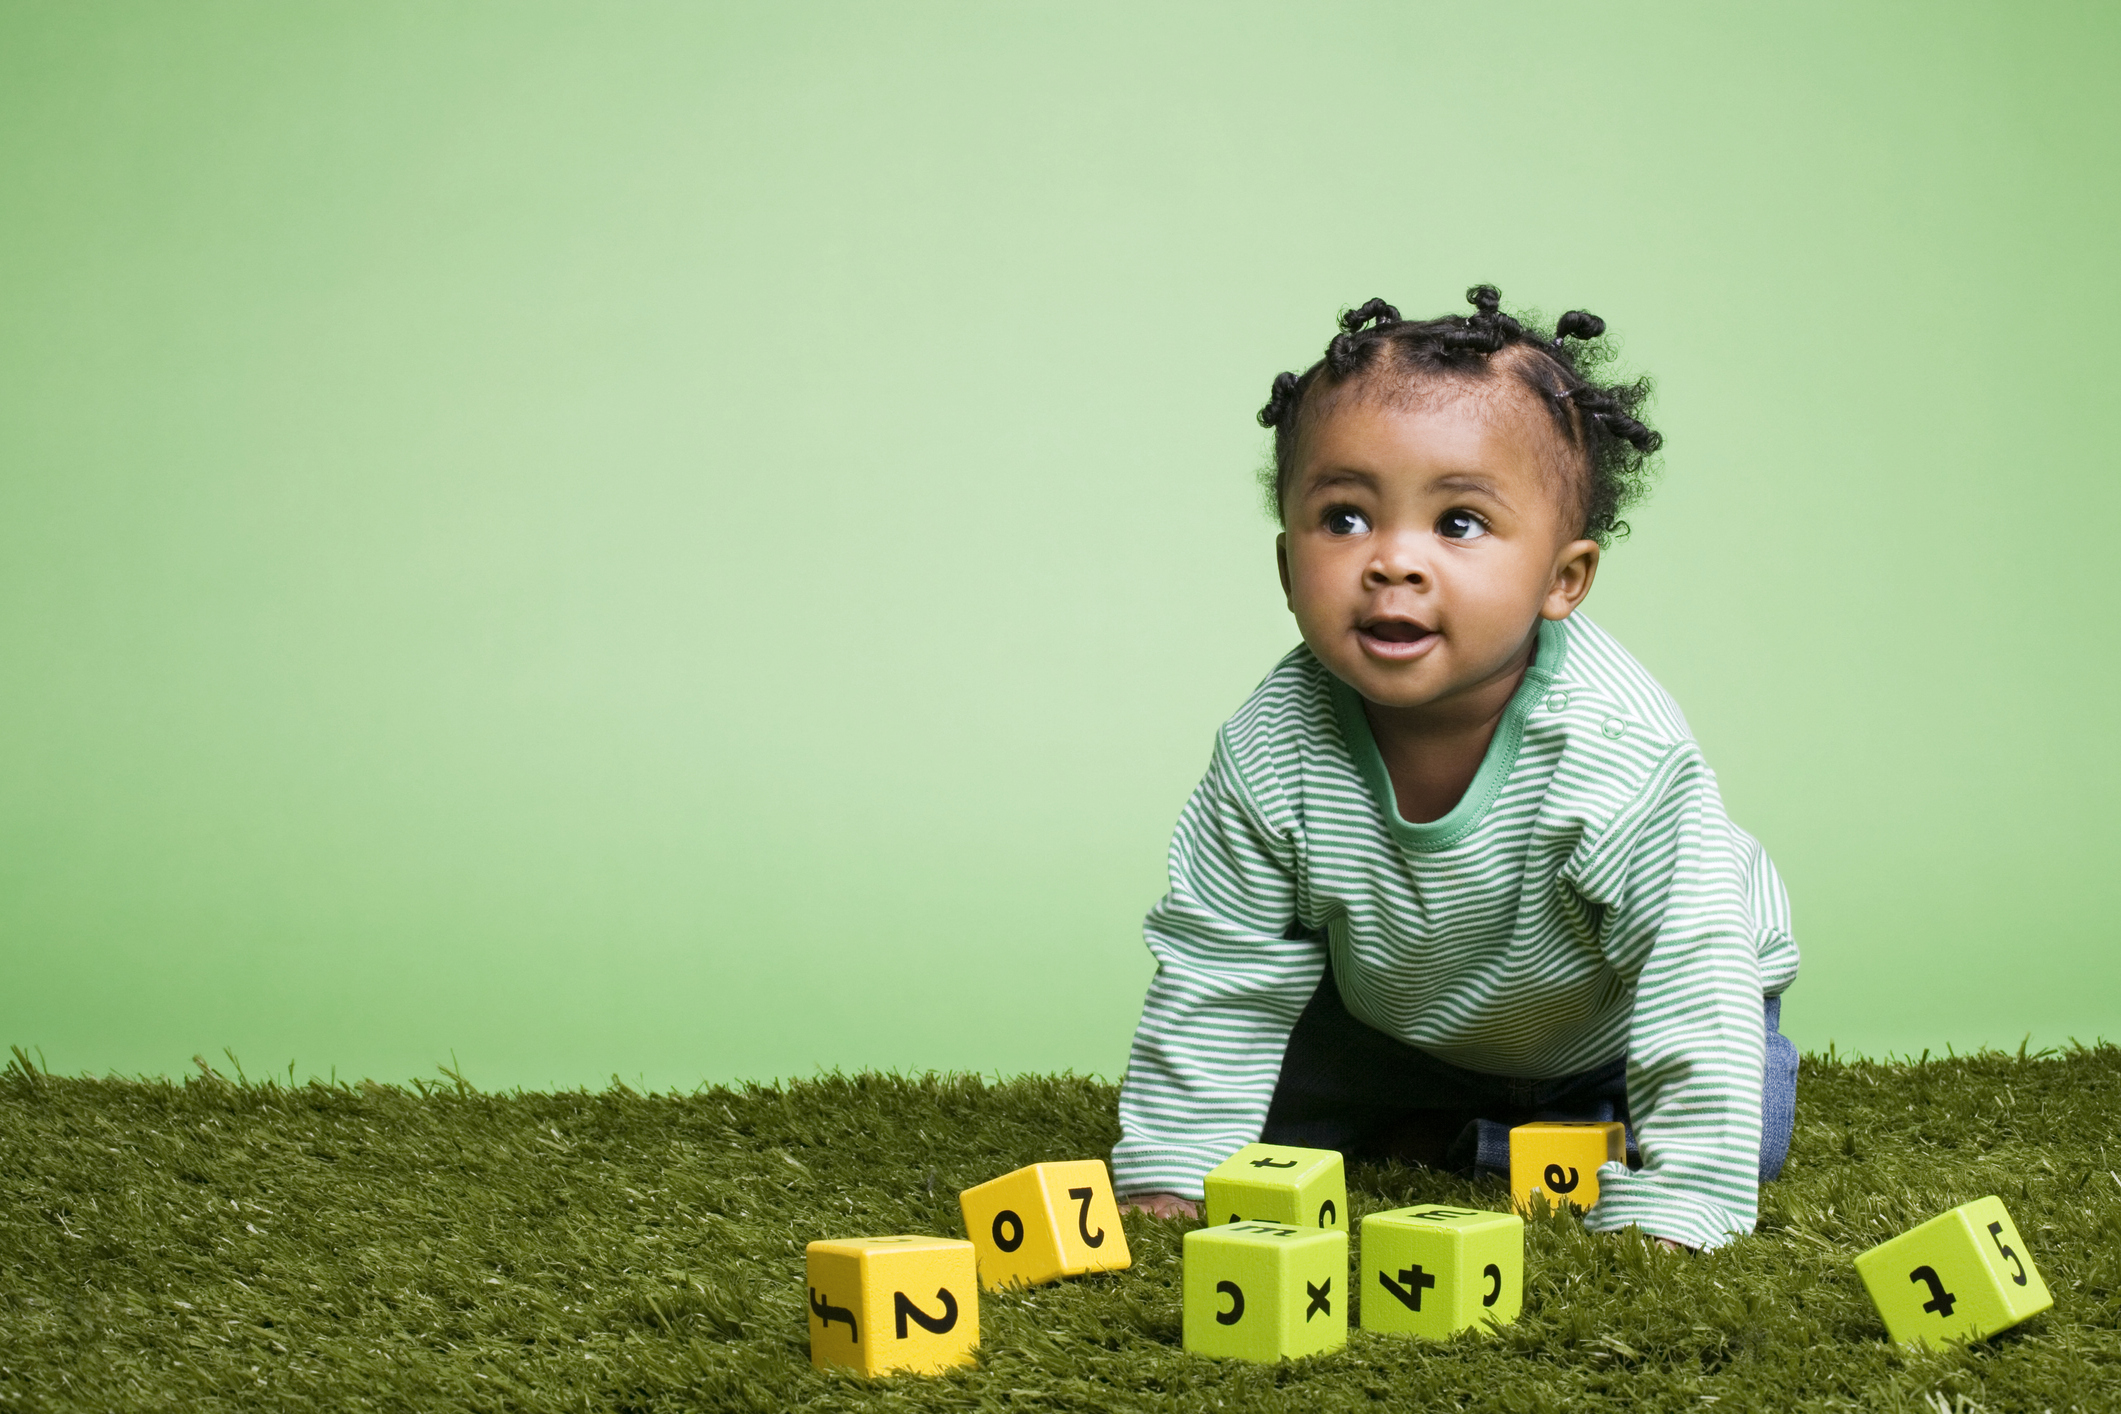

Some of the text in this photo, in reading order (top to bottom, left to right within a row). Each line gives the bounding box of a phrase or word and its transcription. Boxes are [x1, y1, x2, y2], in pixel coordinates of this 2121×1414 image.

[1249, 1157, 1298, 1168] t
[1543, 1163, 1579, 1195] e
[991, 1209, 1024, 1253] o
[1068, 1187, 1105, 1249] 2
[1987, 1221, 2028, 1287] 5
[1215, 1280, 1245, 1326] c
[1306, 1277, 1331, 1323] x
[1379, 1263, 1436, 1313] 4
[1482, 1263, 1502, 1307] c
[1909, 1265, 1957, 1318] t
[809, 1286, 858, 1344] f
[894, 1287, 958, 1340] 2
